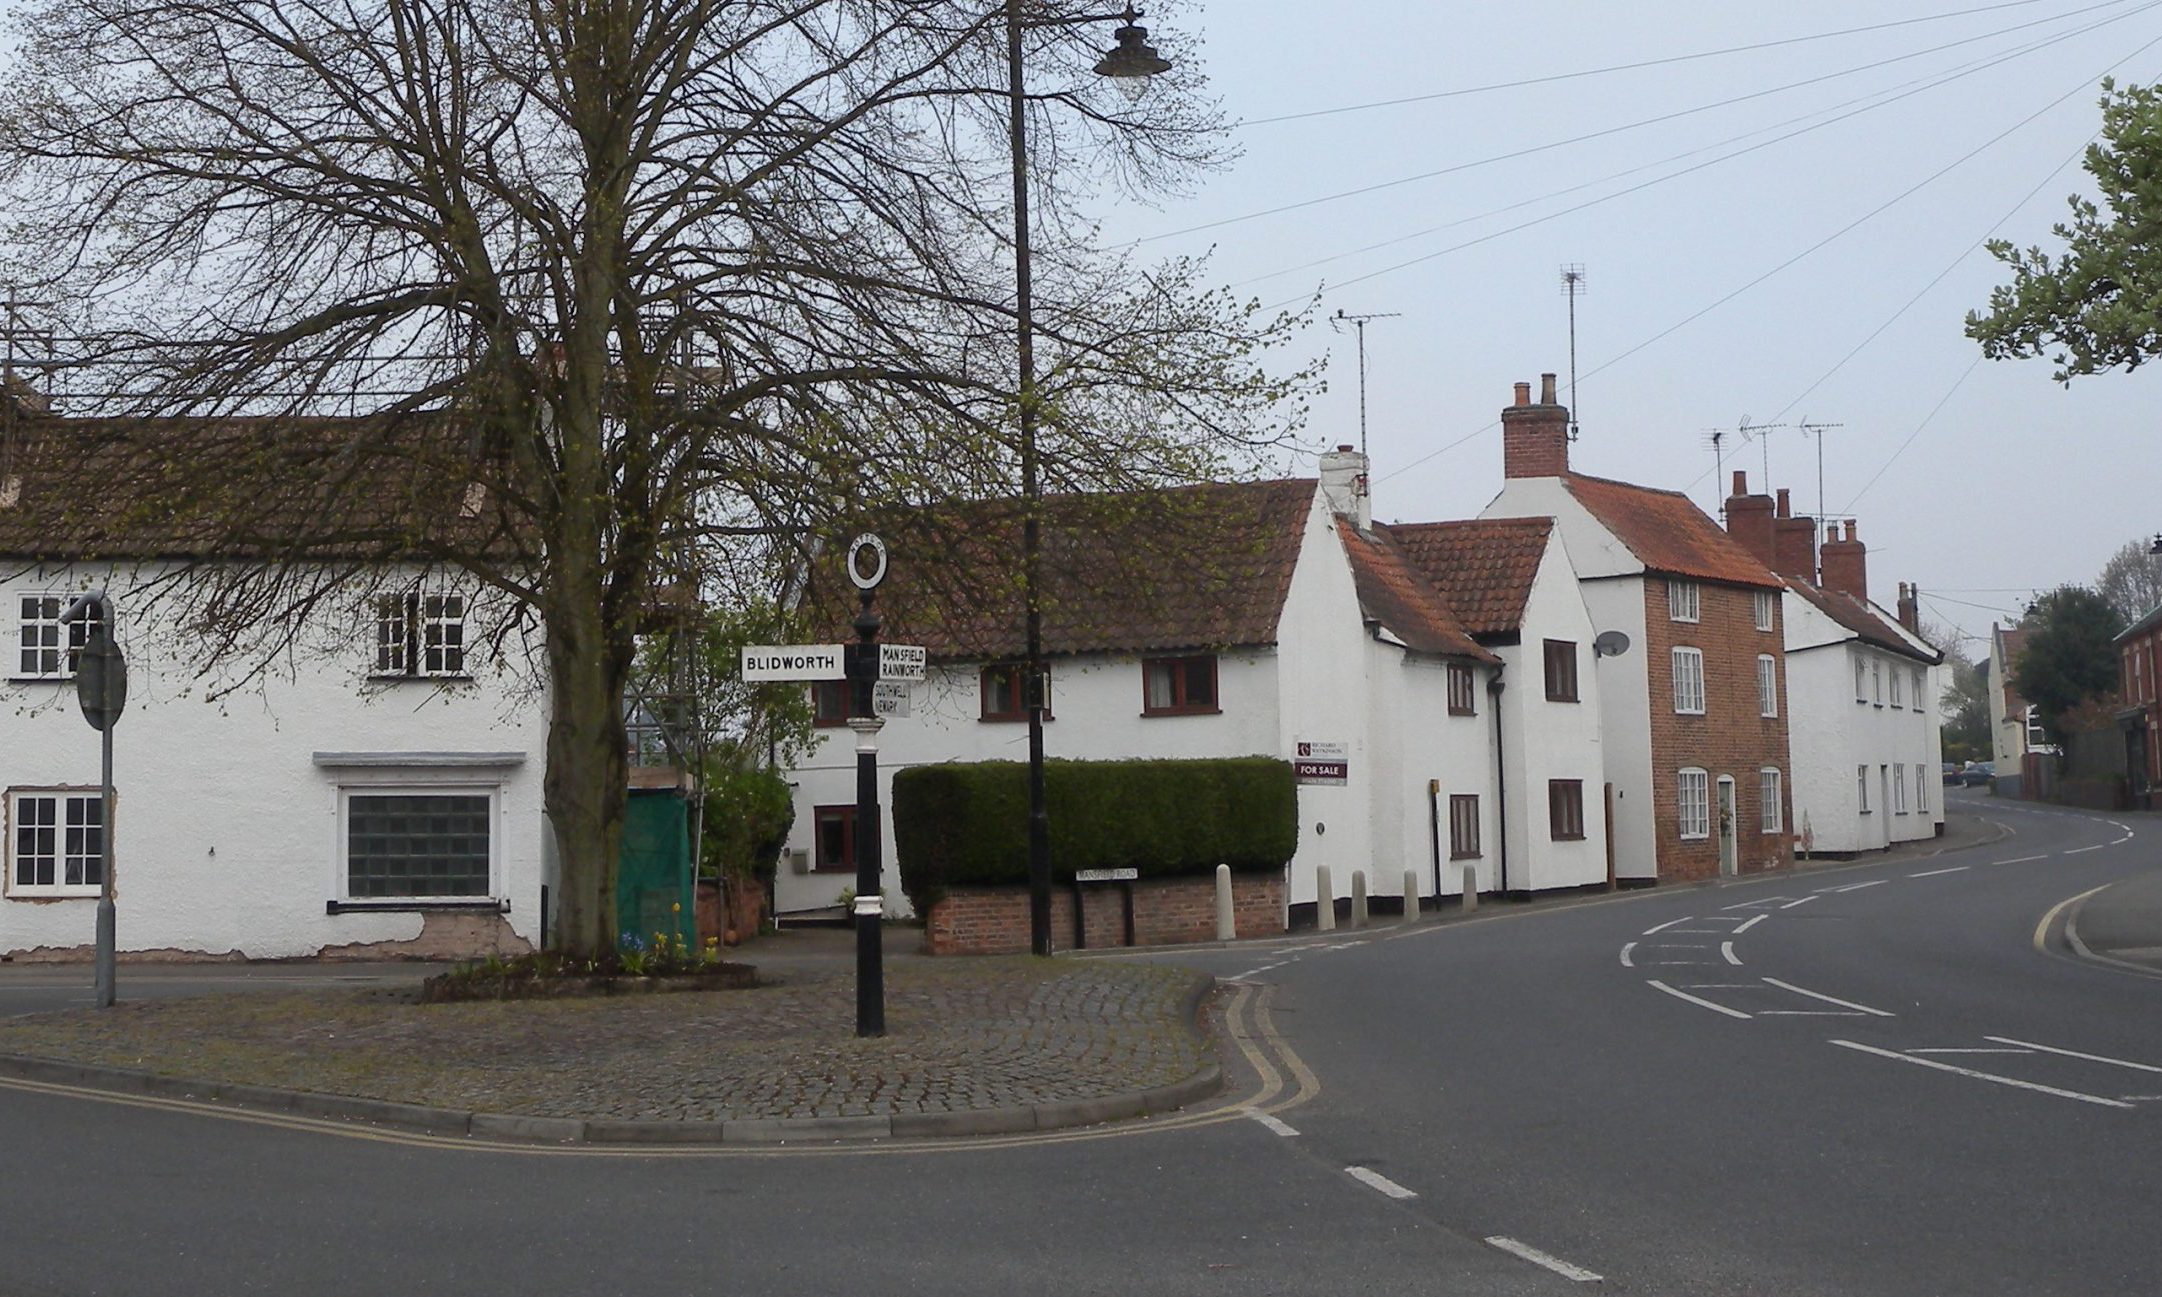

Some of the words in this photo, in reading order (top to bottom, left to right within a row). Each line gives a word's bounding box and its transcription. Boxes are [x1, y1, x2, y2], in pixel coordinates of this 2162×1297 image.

[882, 647, 924, 662] MANSFIELD
[747, 656, 835, 670] BLIDWORTH
[882, 663, 925, 678] RAINWORTH
[1300, 765, 1317, 775] FOR
[1318, 766, 1339, 775] SALE
[1079, 870, 1114, 879] MANSFIELD
[1117, 869, 1136, 878] ROAD
